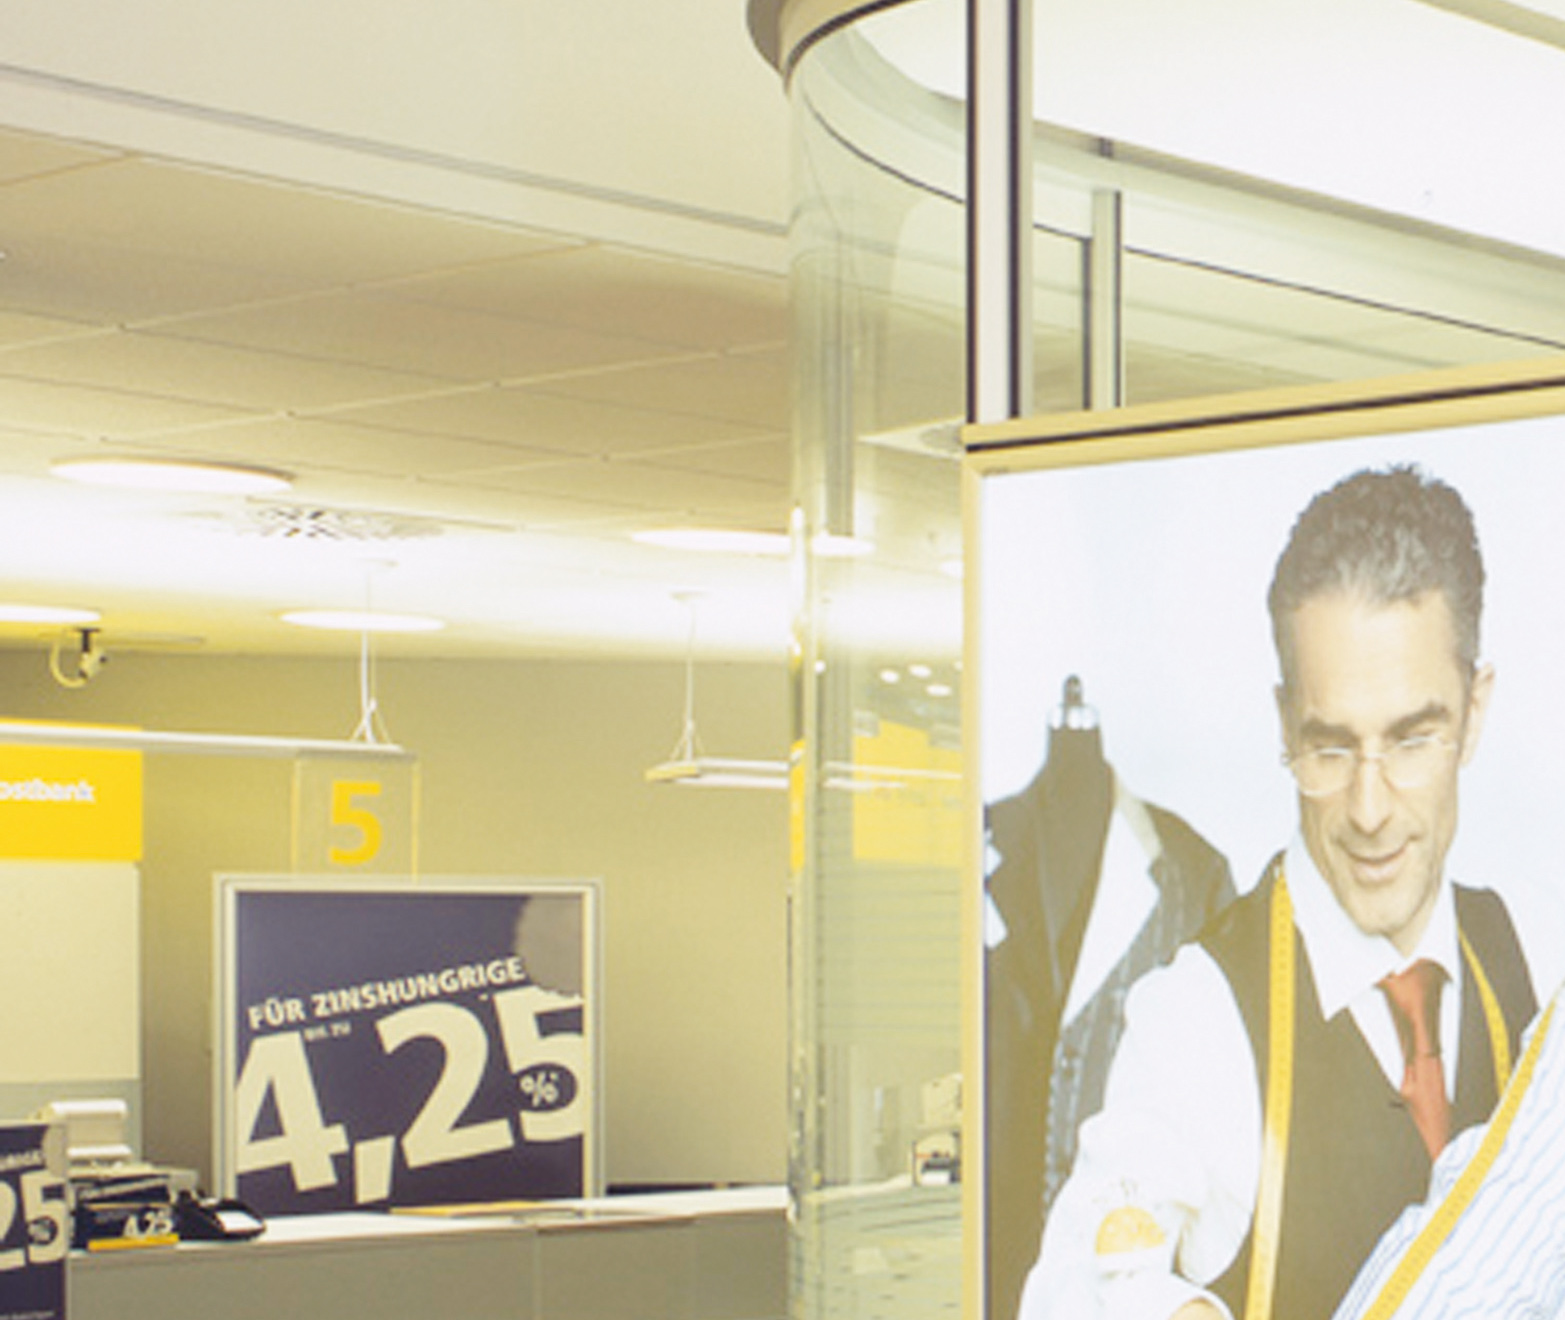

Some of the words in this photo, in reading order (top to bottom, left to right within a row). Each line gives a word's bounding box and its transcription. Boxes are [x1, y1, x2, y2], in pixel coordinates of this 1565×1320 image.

[330, 780, 383, 868] 5
[249, 997, 306, 1029] FÜR
[311, 956, 526, 1018] ZINSHUNGRIGE
[236, 986, 583, 1204] 4,25
